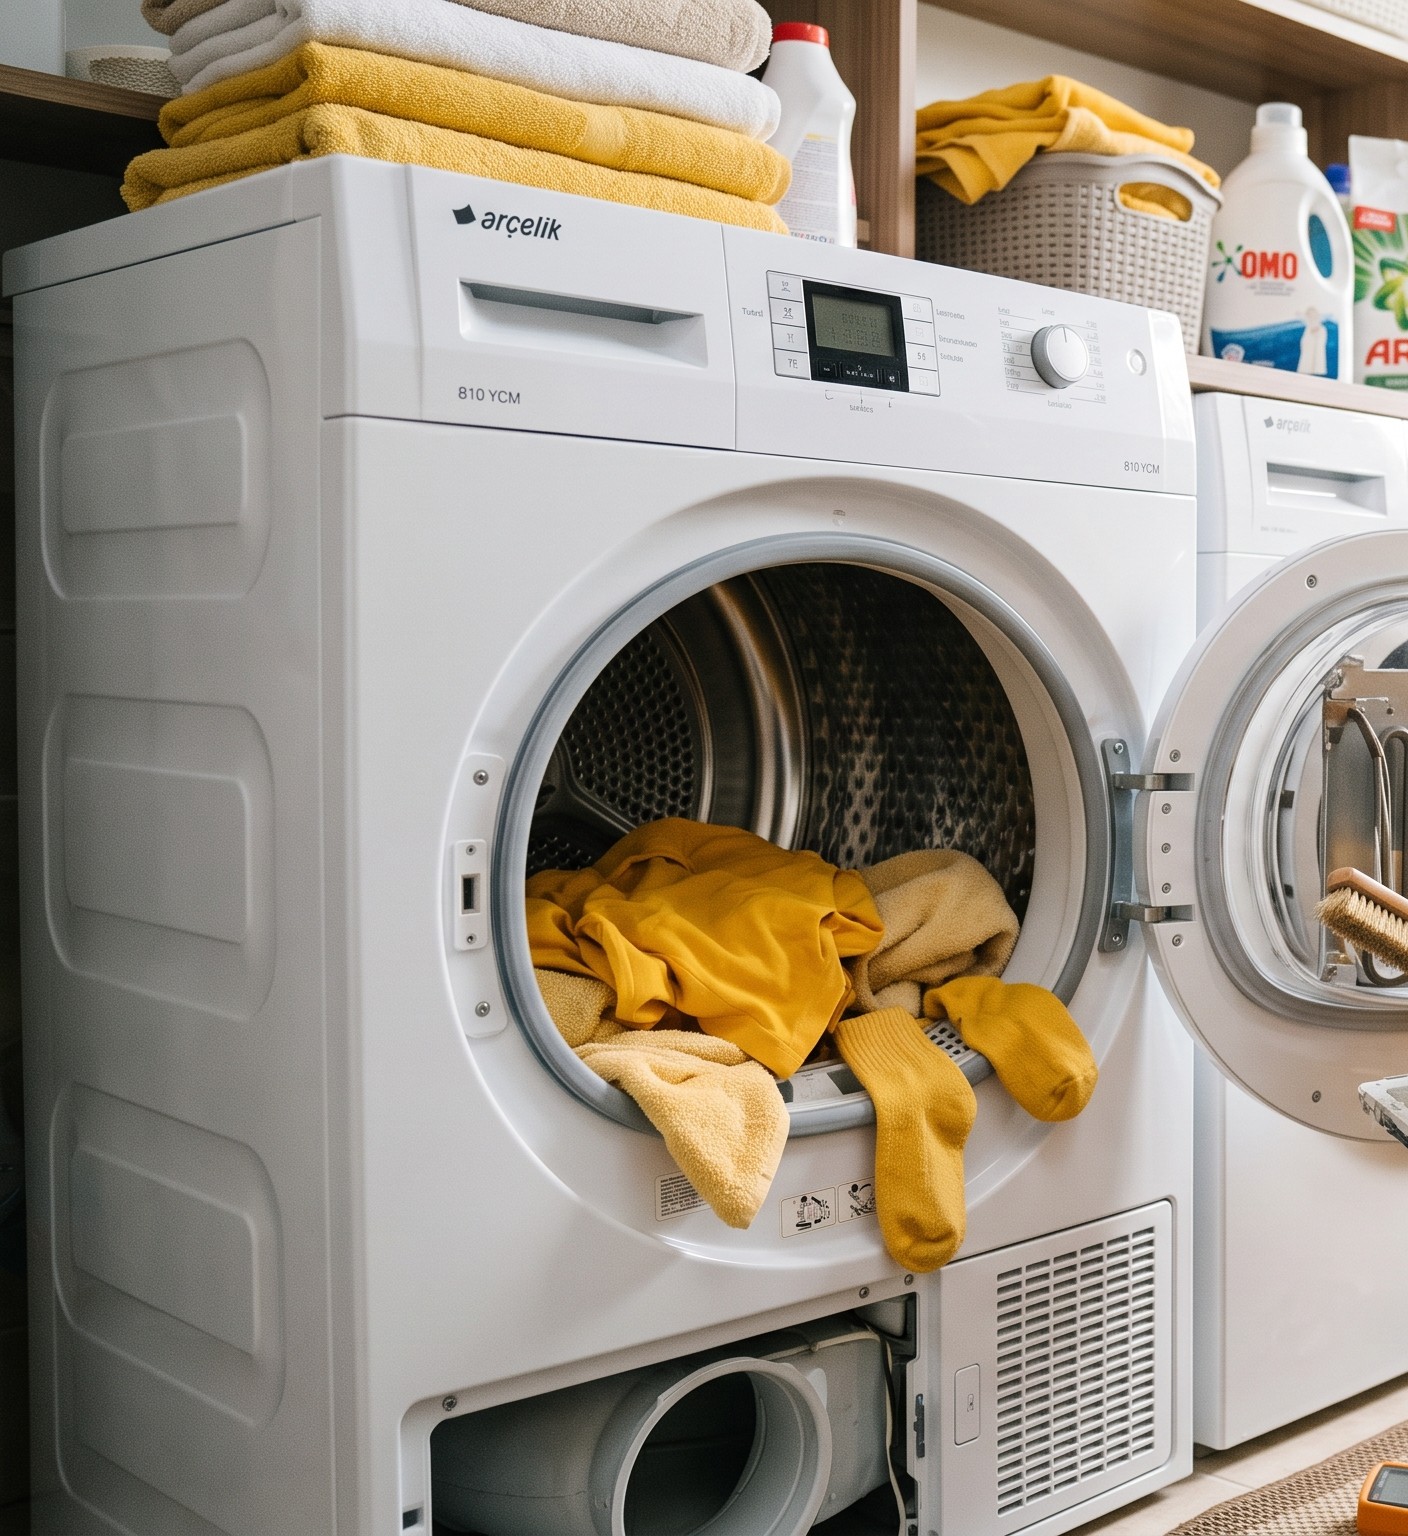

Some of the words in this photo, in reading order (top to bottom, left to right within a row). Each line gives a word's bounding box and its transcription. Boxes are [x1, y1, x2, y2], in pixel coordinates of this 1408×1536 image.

[480, 210, 562, 241] arçelik
[1241, 250, 1298, 280] OMO
[457, 386, 485, 402] 810
[488, 389, 521, 405] YCM
[1123, 461, 1140, 473] 810
[1141, 463, 1160, 475] YCM
